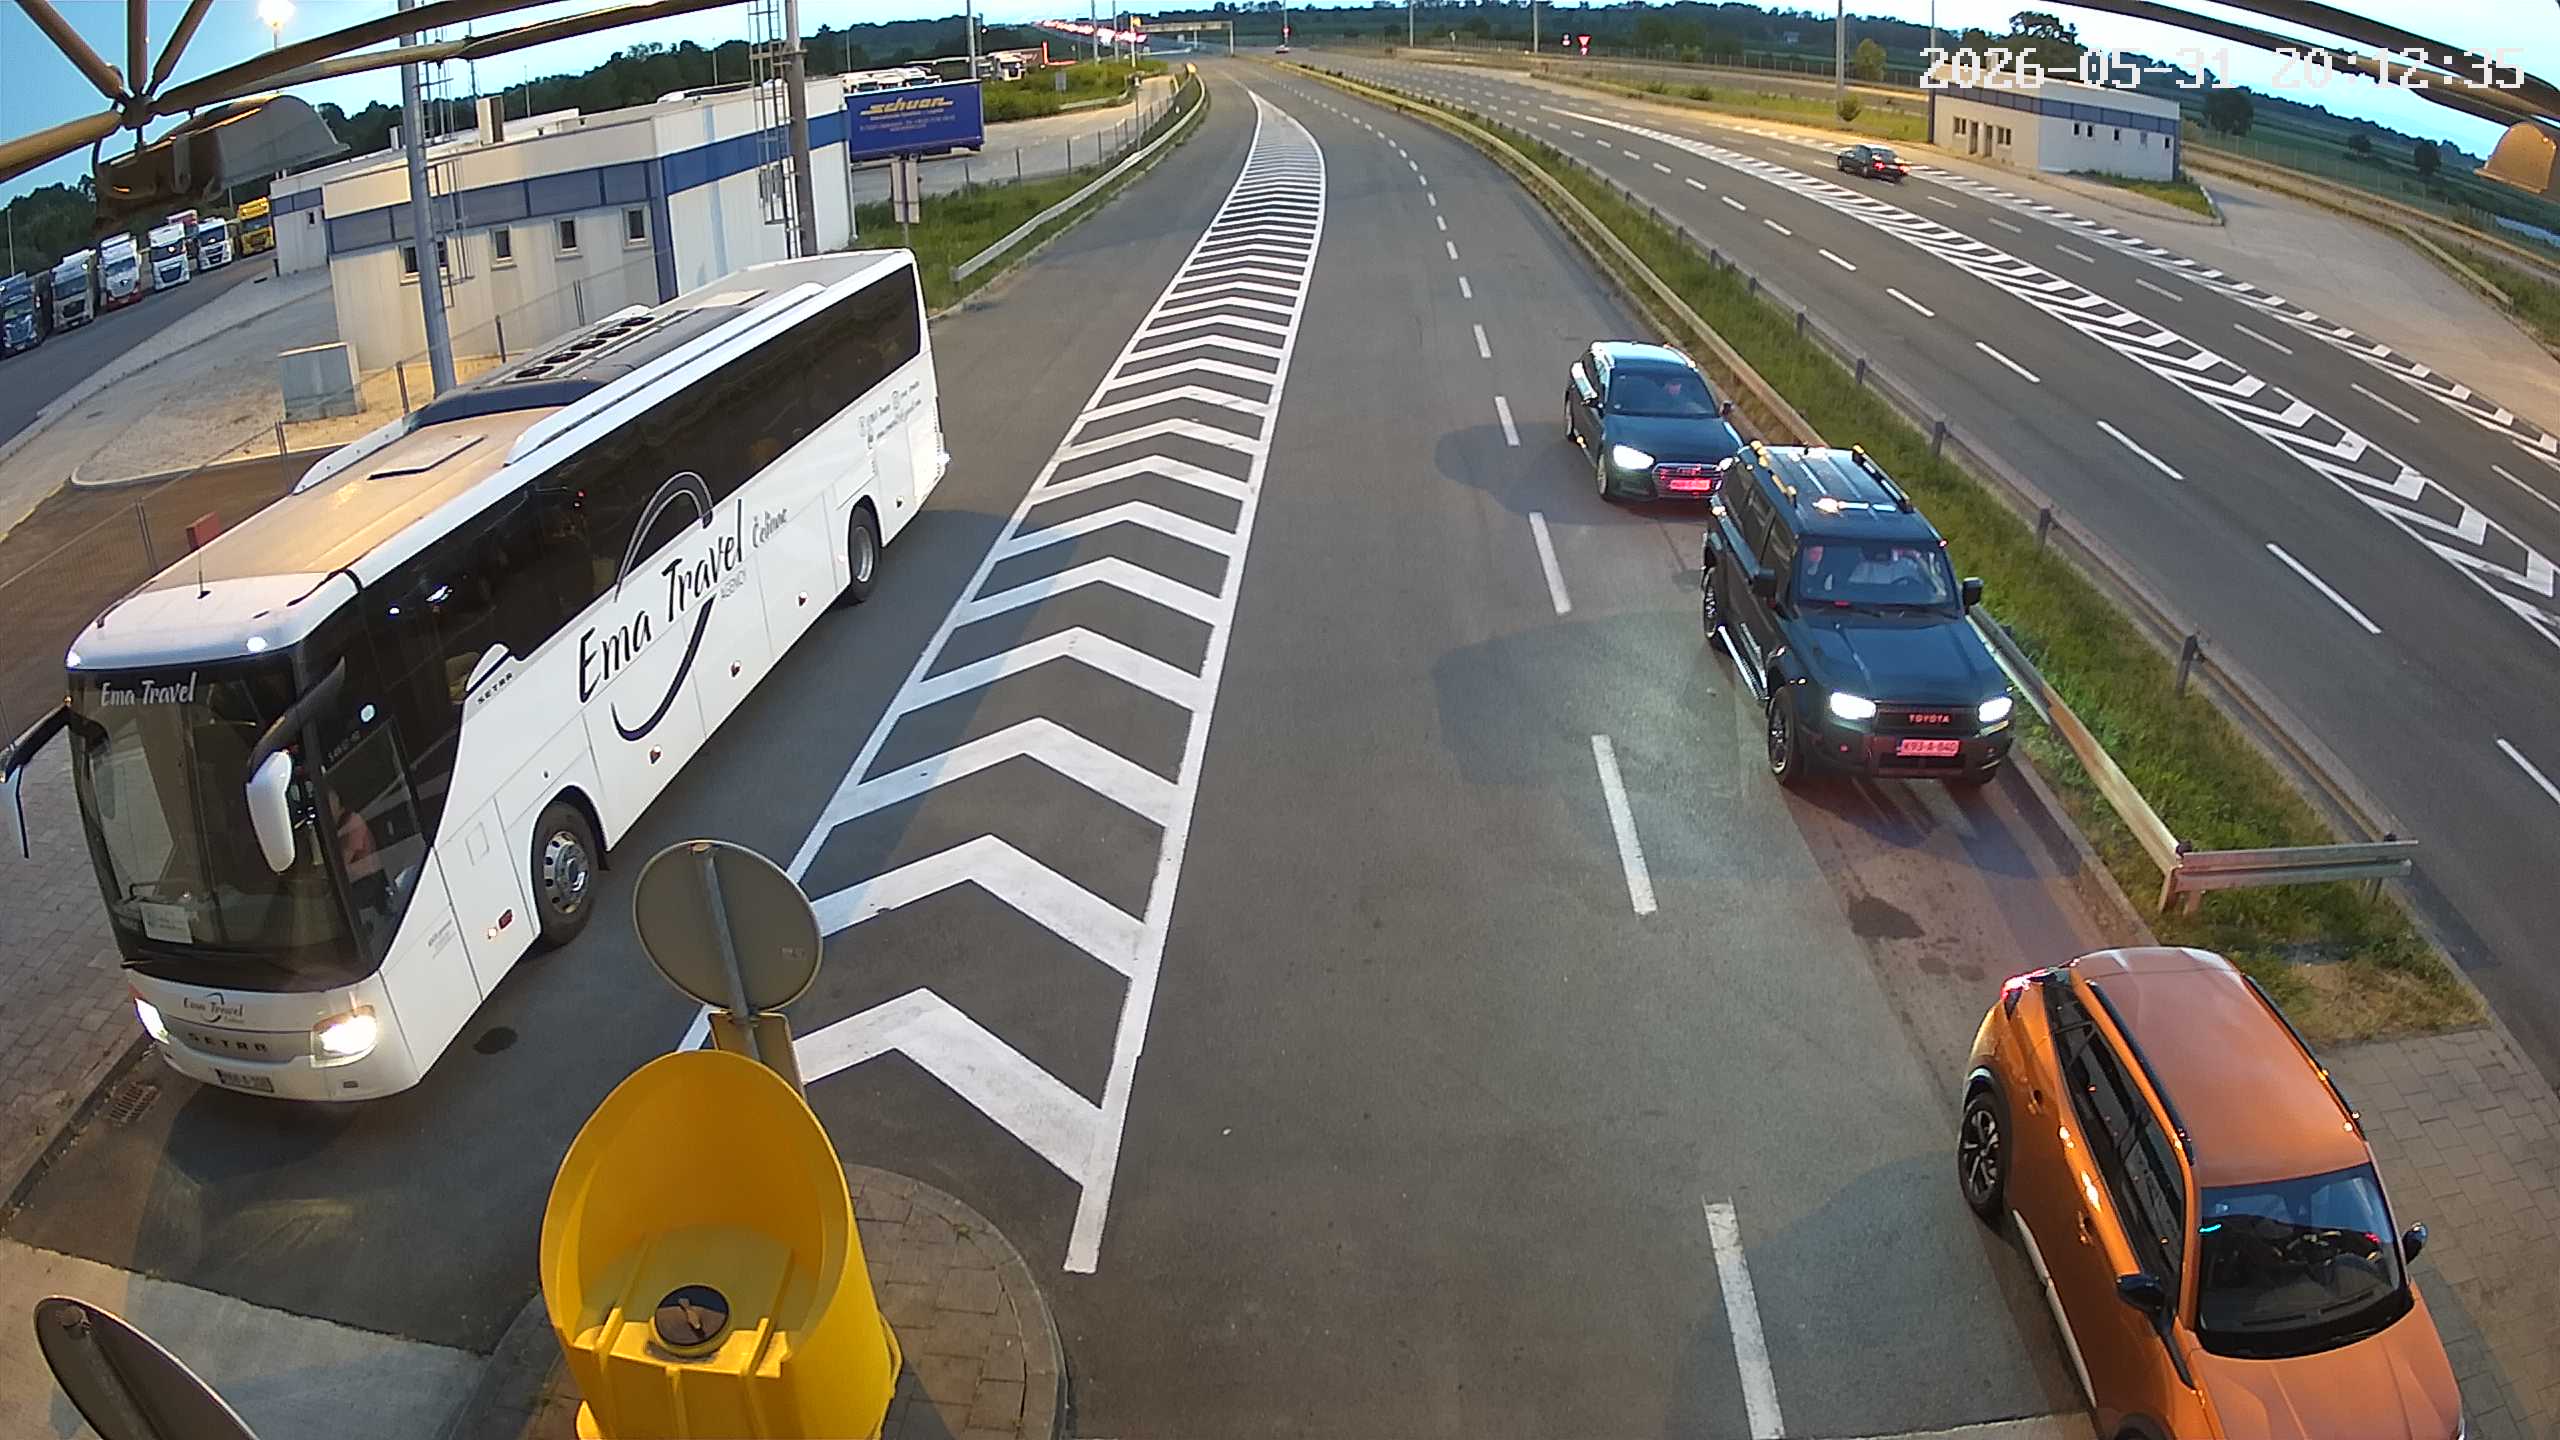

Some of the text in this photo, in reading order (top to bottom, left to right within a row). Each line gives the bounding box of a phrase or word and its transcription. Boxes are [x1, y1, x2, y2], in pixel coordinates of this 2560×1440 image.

[579, 610, 652, 703] Ema
[661, 498, 743, 623] Travel
[101, 671, 198, 707] Ema Travel
[1908, 713, 1950, 724] TOYOTA
